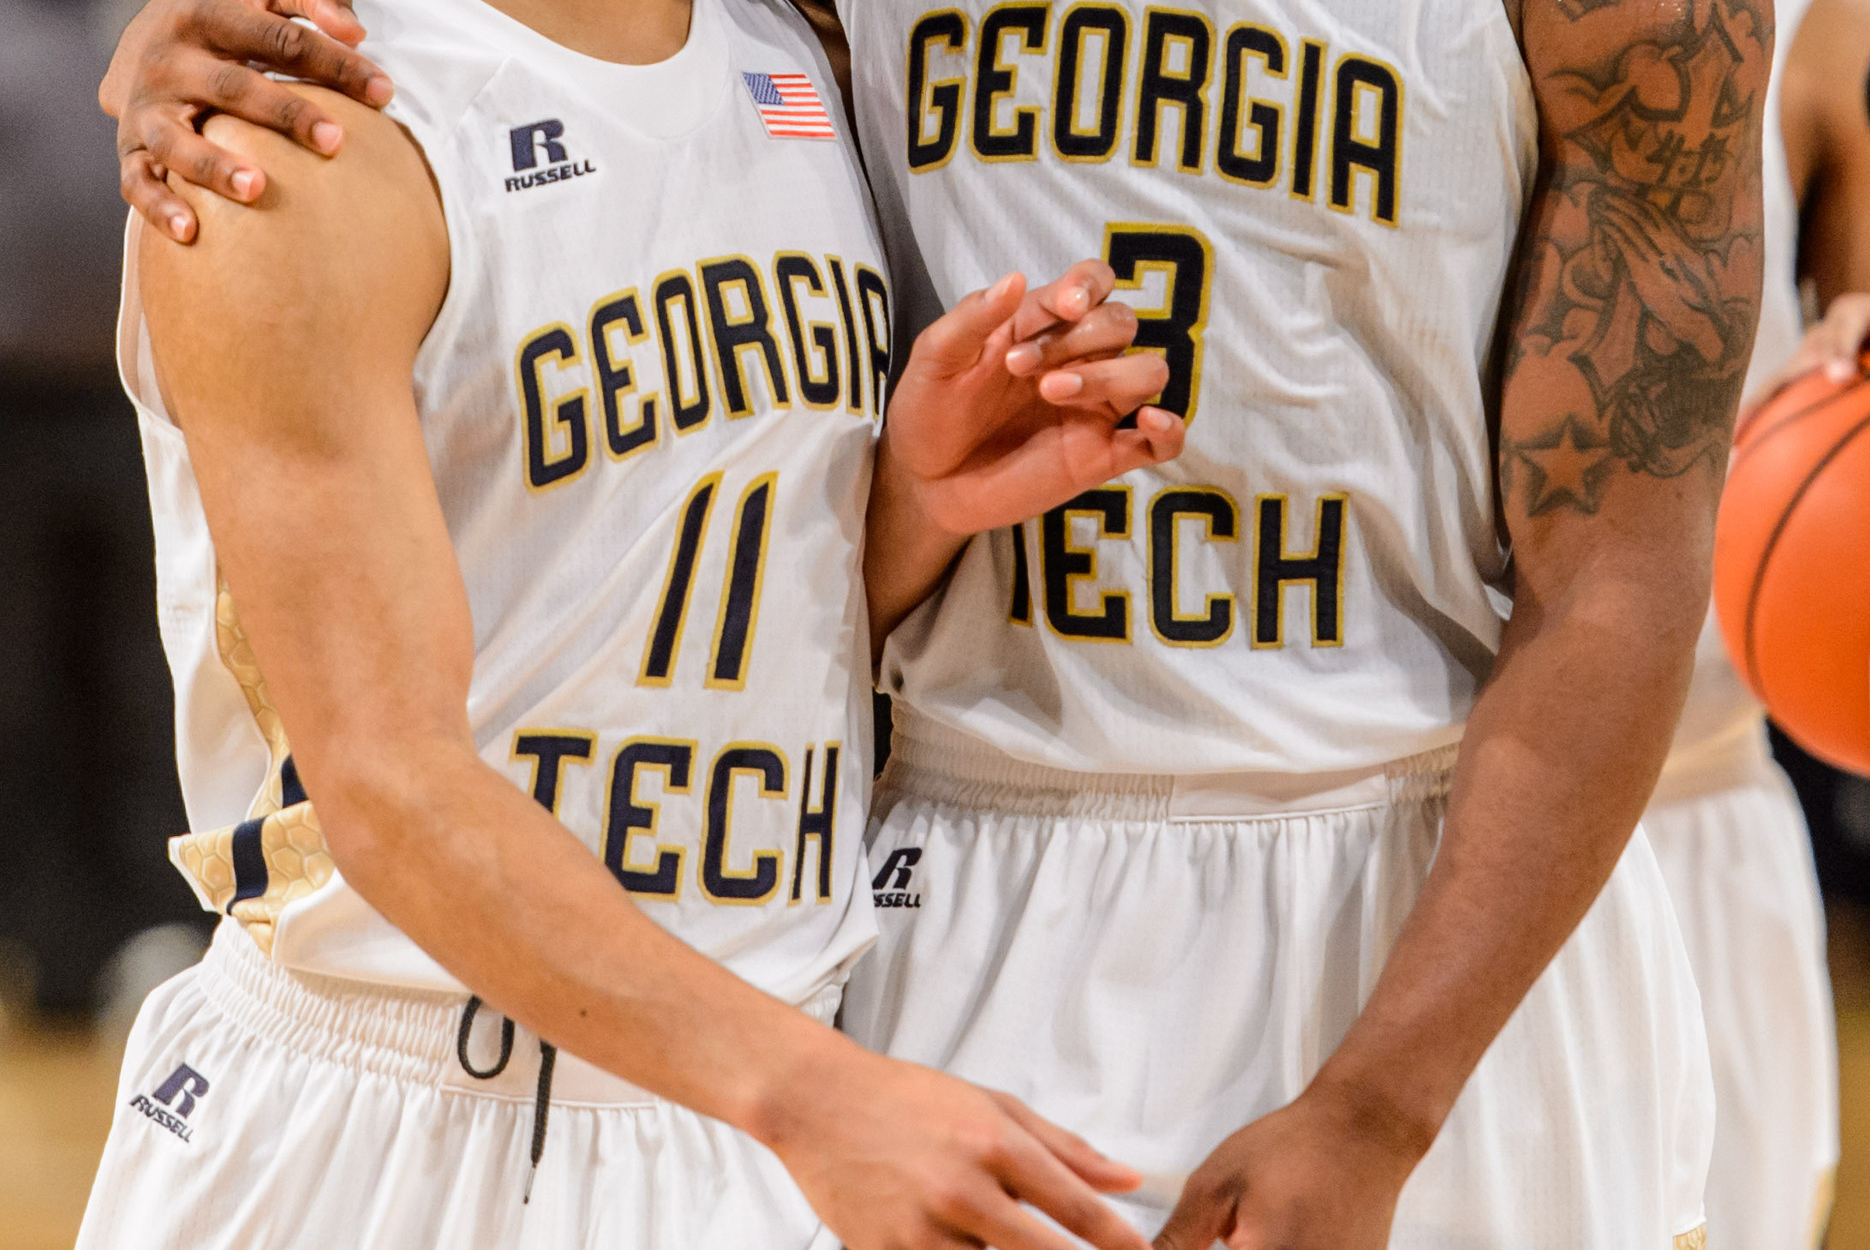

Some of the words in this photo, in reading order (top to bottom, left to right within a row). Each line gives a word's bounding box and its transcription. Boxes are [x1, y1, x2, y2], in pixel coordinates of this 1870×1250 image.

[510, 118, 568, 172] R
[907, 1, 1404, 229] GEORGIA
[504, 159, 597, 193] RUSSELL
[514, 250, 892, 495] GEORGIA
[1104, 222, 1215, 430] 3
[634, 469, 779, 691] 11
[509, 728, 842, 905] TECH
[873, 892, 921, 908] SSELL
[129, 1094, 194, 1143] RUSSELL
[152, 1062, 210, 1119] R
